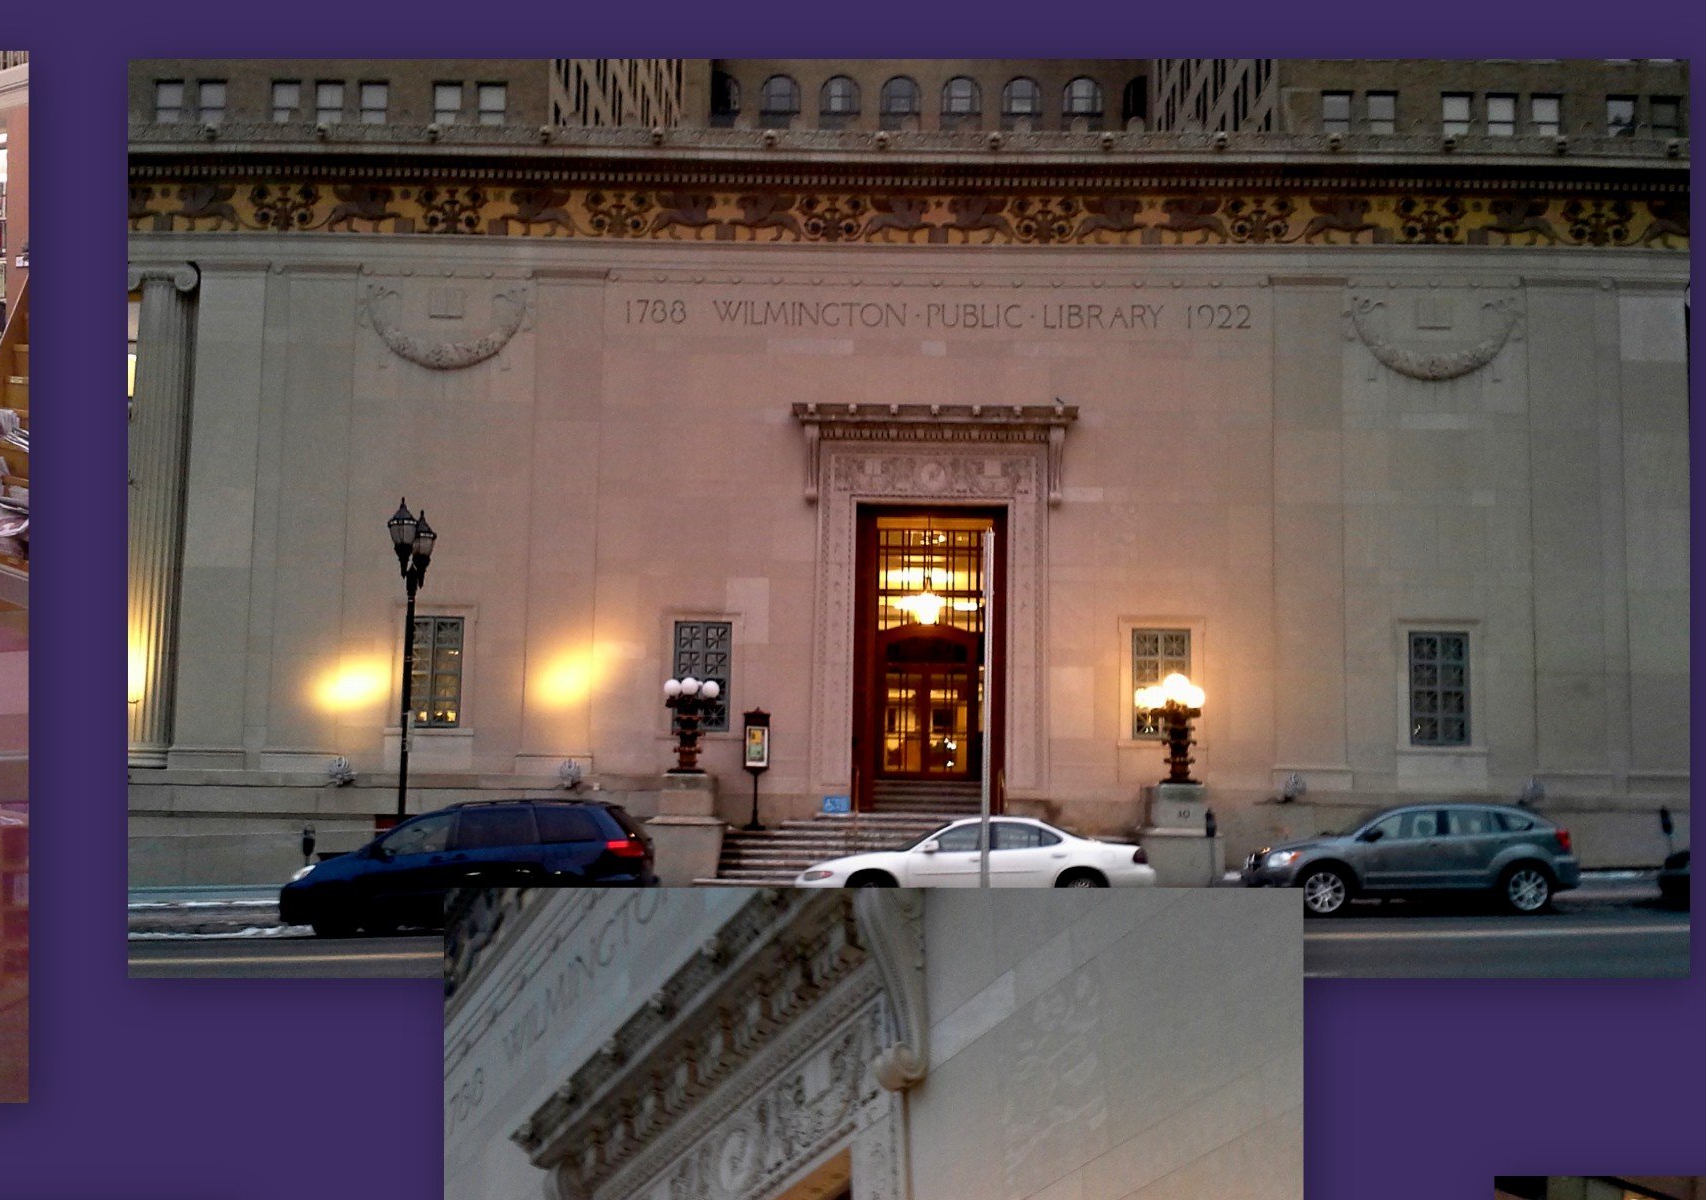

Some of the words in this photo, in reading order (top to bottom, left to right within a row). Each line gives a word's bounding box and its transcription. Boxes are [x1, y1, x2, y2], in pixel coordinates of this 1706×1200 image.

[625, 299, 688, 325] 1788
[711, 301, 908, 328] WILMINGTON
[926, 303, 1023, 329] PUBLIC
[1042, 303, 1165, 330] LIBRARY
[1186, 304, 1252, 330] 1922
